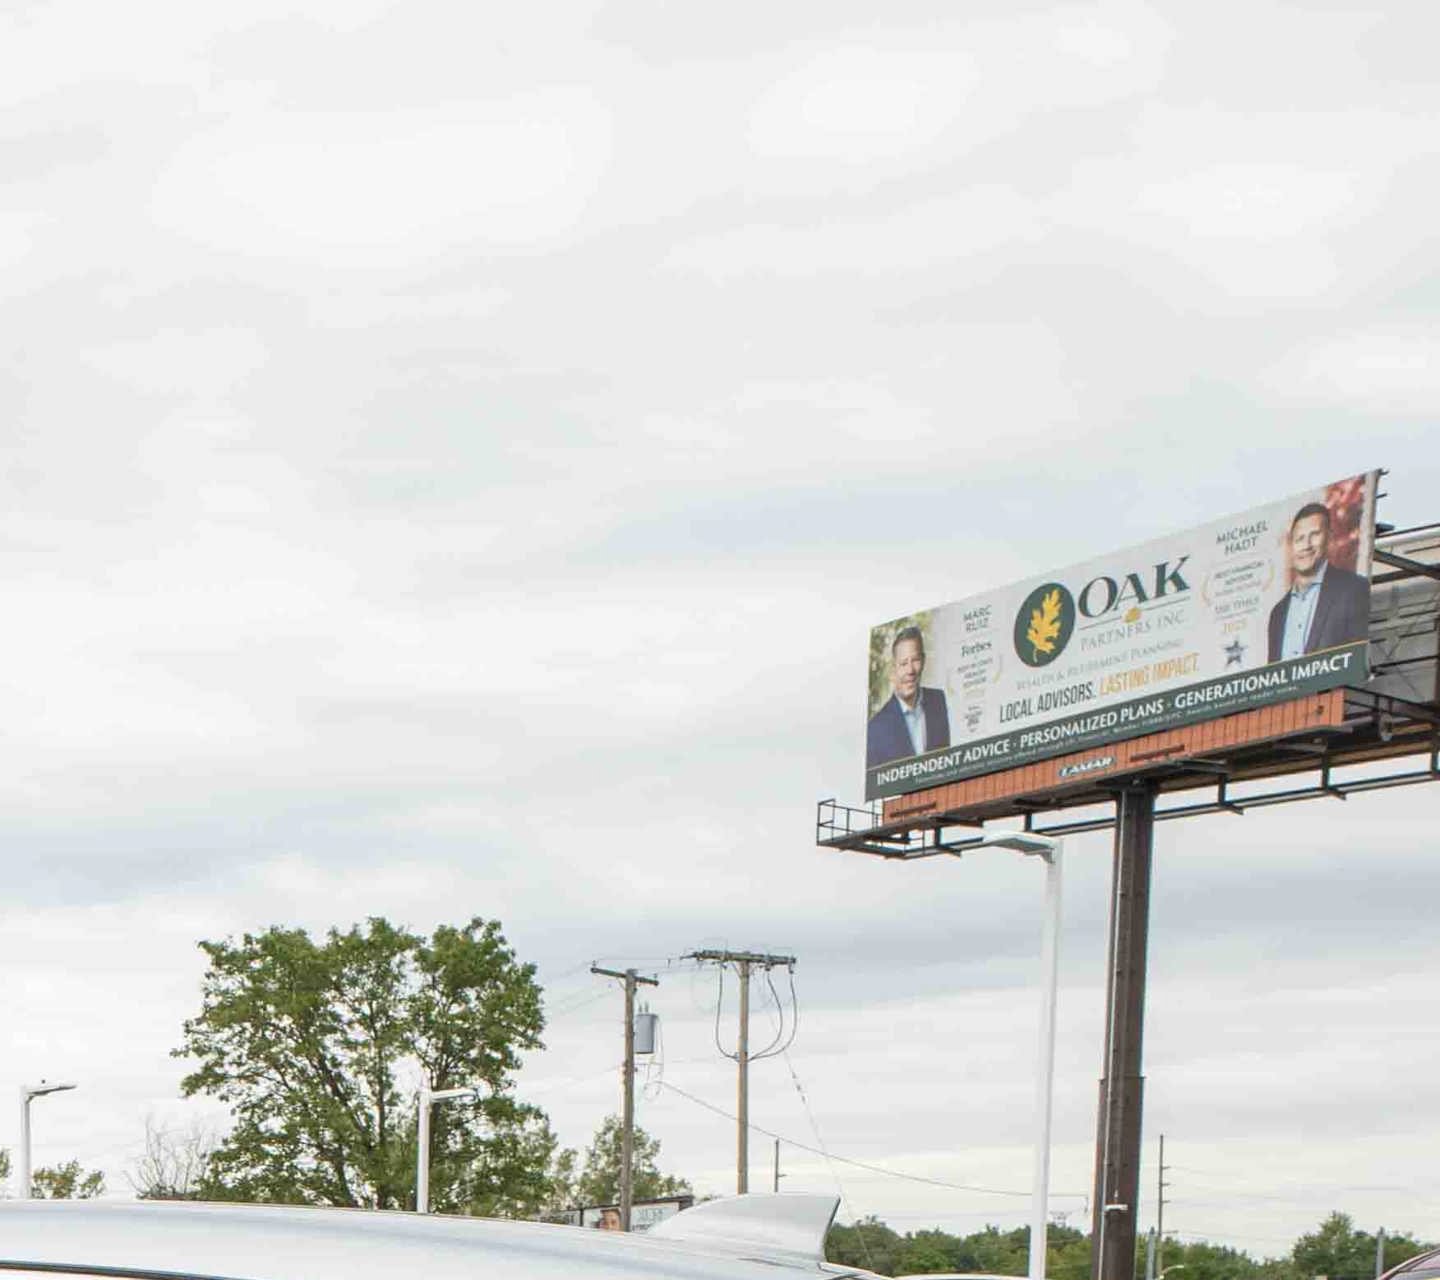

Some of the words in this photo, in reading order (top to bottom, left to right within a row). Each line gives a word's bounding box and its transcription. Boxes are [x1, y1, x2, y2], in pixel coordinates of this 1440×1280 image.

[1216, 520, 1269, 545] MICHAEL
[1224, 535, 1258, 556] HADT
[1078, 554, 1191, 618] OAK
[963, 604, 993, 622] MARC
[966, 616, 990, 633] RUIZ
[1080, 621, 1152, 652] PARTNERS
[1156, 610, 1186, 629] INC
[961, 641, 993, 657] Forbes
[1130, 639, 1183, 662] PLANNING
[999, 698, 1034, 723] LOCAL
[1037, 681, 1097, 714] ADVISORS.
[1099, 664, 1151, 696] LASTING
[877, 751, 961, 786] INDEPENDENT
[963, 738, 1010, 764] ADVICE
[1020, 711, 1119, 749] PERSONALIZED
[1120, 698, 1165, 723] PLANS
[1174, 669, 1289, 709] GENERATIONAL
[1291, 652, 1353, 681] IMPACT
[1061, 757, 1114, 777] LAMAR
